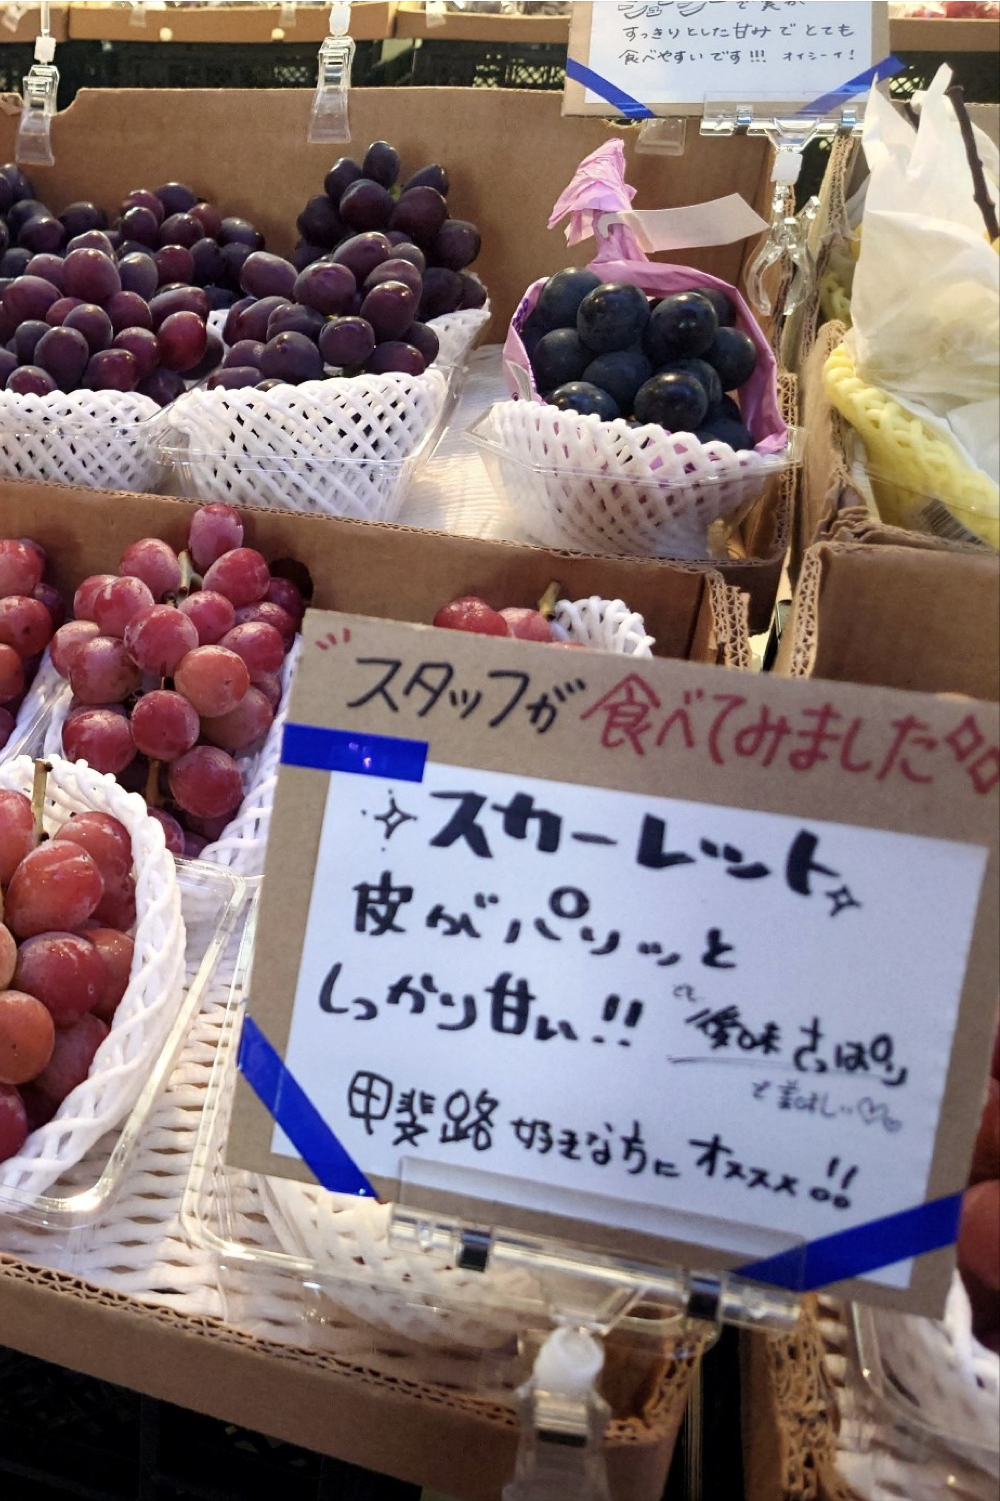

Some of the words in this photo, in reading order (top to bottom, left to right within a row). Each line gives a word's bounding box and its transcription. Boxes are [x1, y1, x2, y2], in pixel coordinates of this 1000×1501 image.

[346, 656, 946, 784] スタッフが食べてみました
[429, 789, 843, 901] スカーレット
[350, 871, 739, 971] 皮がパリッと
[316, 961, 645, 1050] しっかり甘い!!
